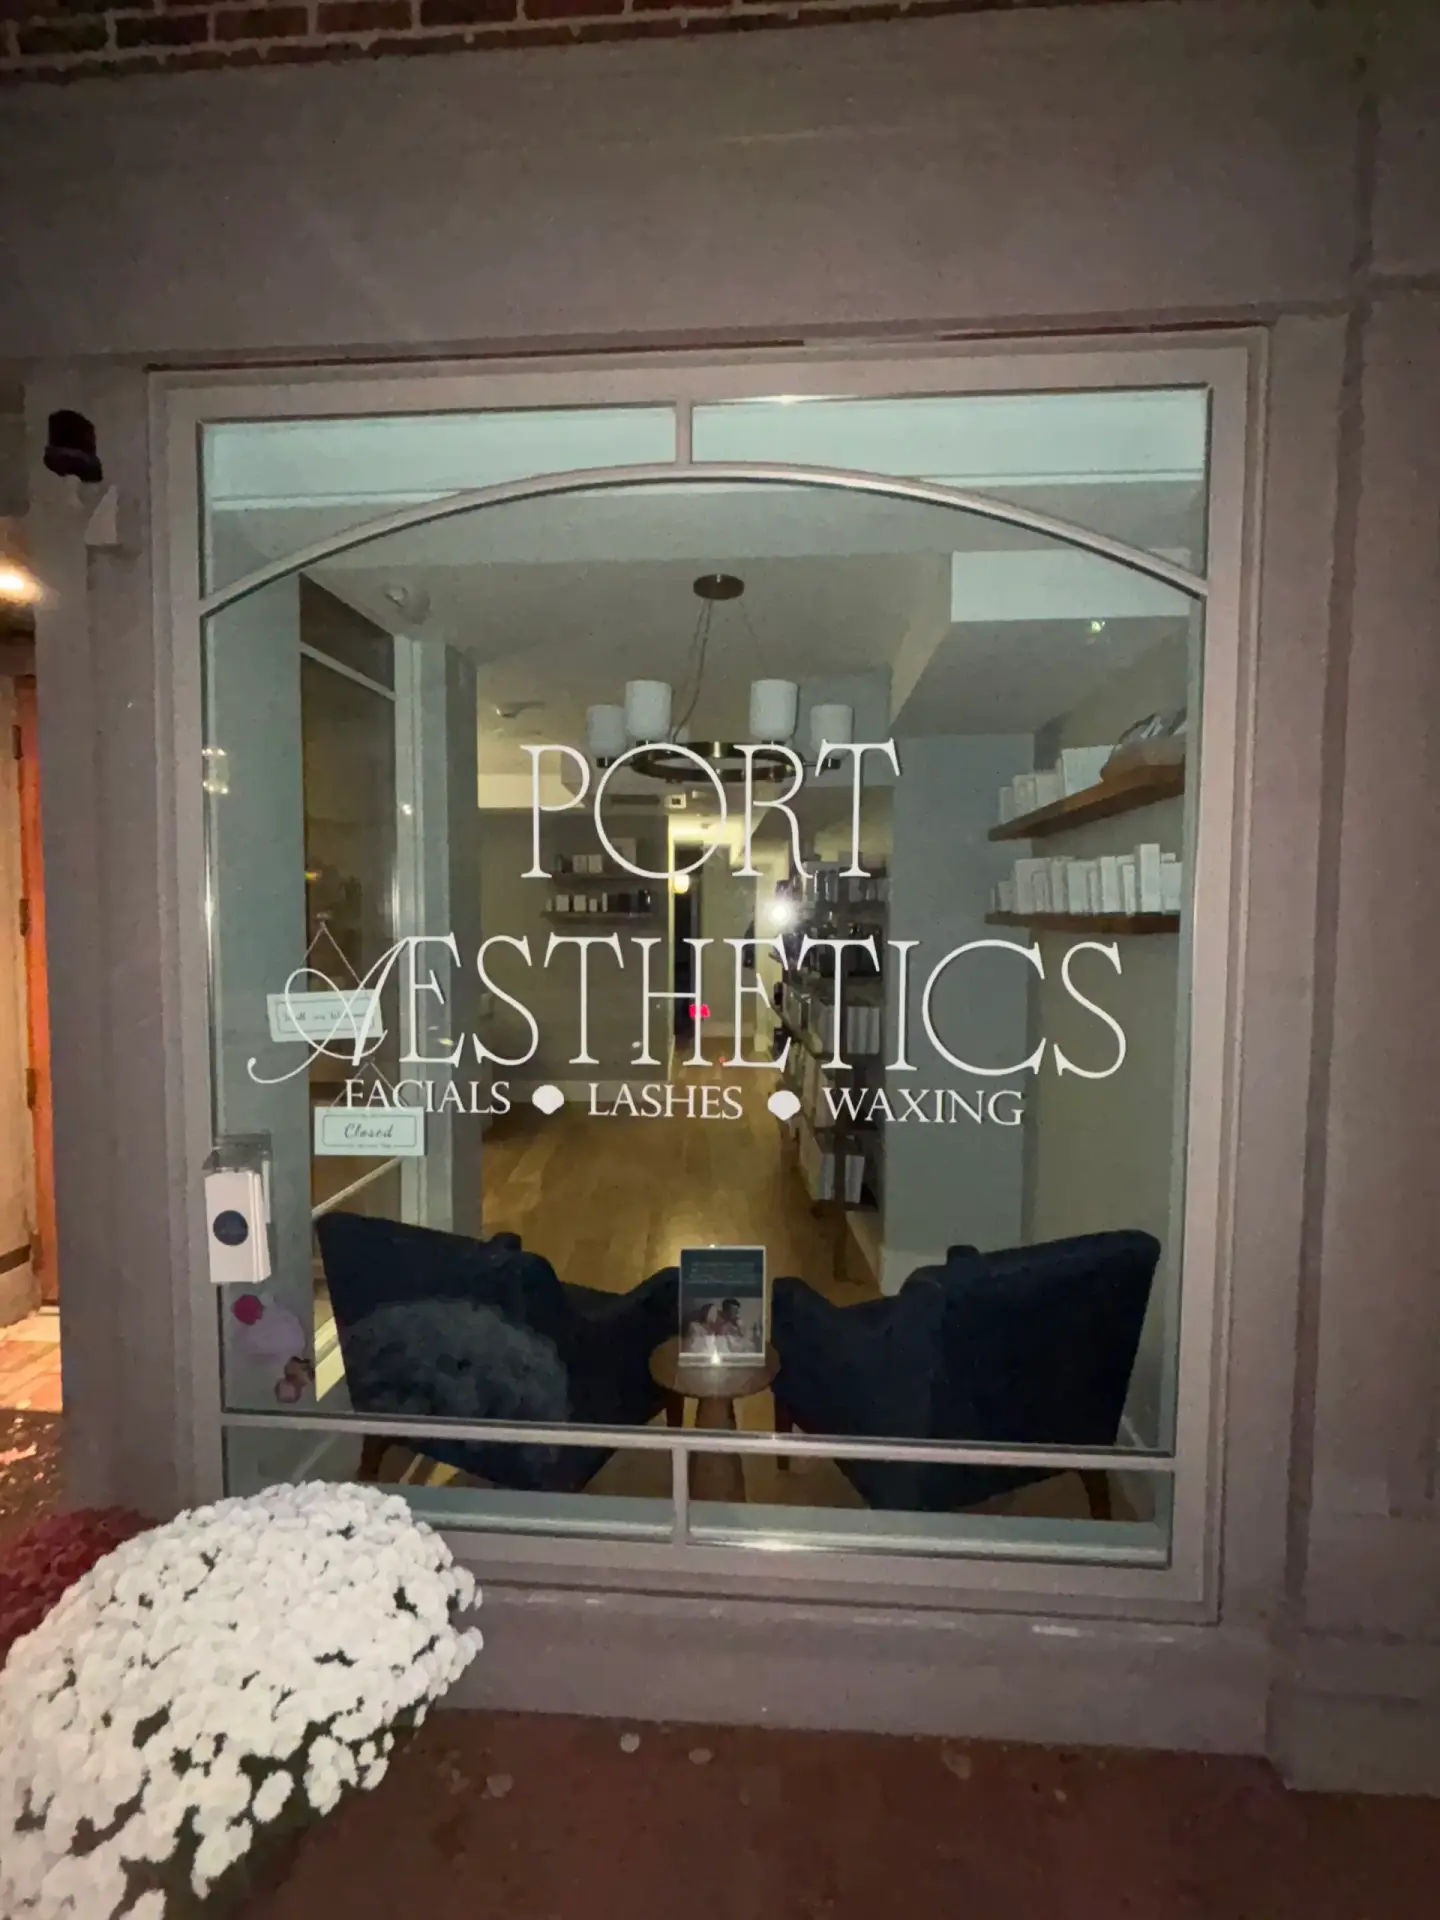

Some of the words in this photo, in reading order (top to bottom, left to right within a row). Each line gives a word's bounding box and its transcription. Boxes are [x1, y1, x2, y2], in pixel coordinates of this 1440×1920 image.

[520, 738, 900, 880] PORT
[343, 1078, 512, 1116] FACIALS
[587, 1082, 743, 1121] LASHES
[821, 1087, 1025, 1126] WAXING
[344, 1122, 394, 1140] Closed
